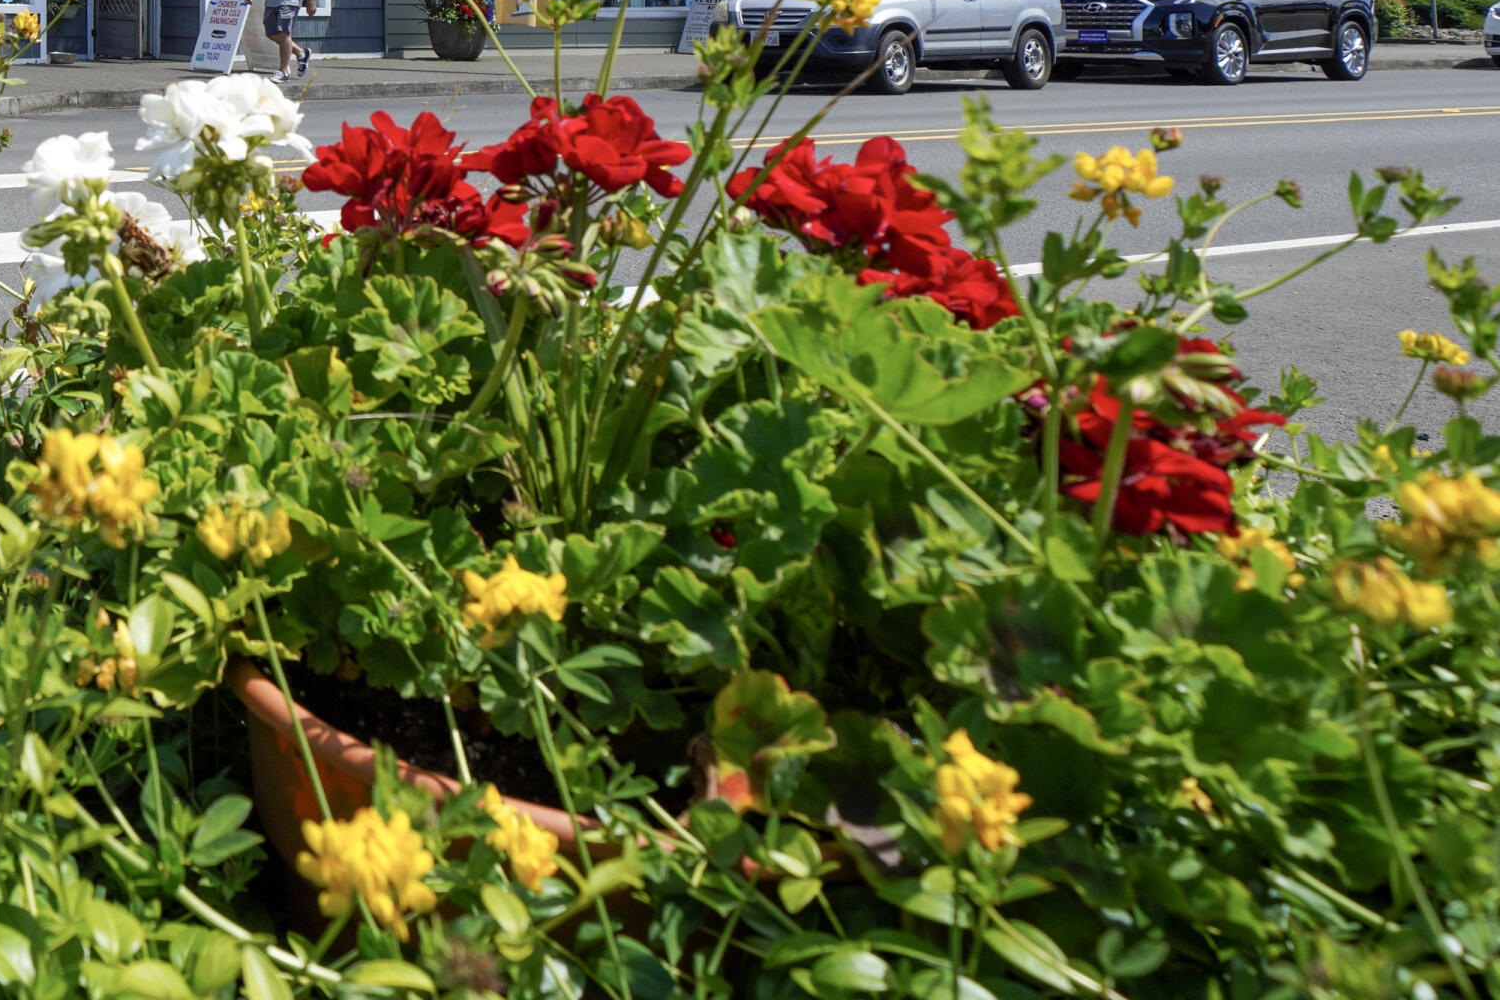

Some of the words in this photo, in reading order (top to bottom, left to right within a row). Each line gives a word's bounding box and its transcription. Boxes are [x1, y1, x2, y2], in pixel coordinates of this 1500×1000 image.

[217, 0, 238, 8] CHOWDER
[212, 8, 221, 16] HOT
[229, 9, 241, 17] COLD
[209, 16, 239, 26] SANDWICHES
[201, 41, 211, 50] BOX
[212, 42, 231, 51] LUNCHES
